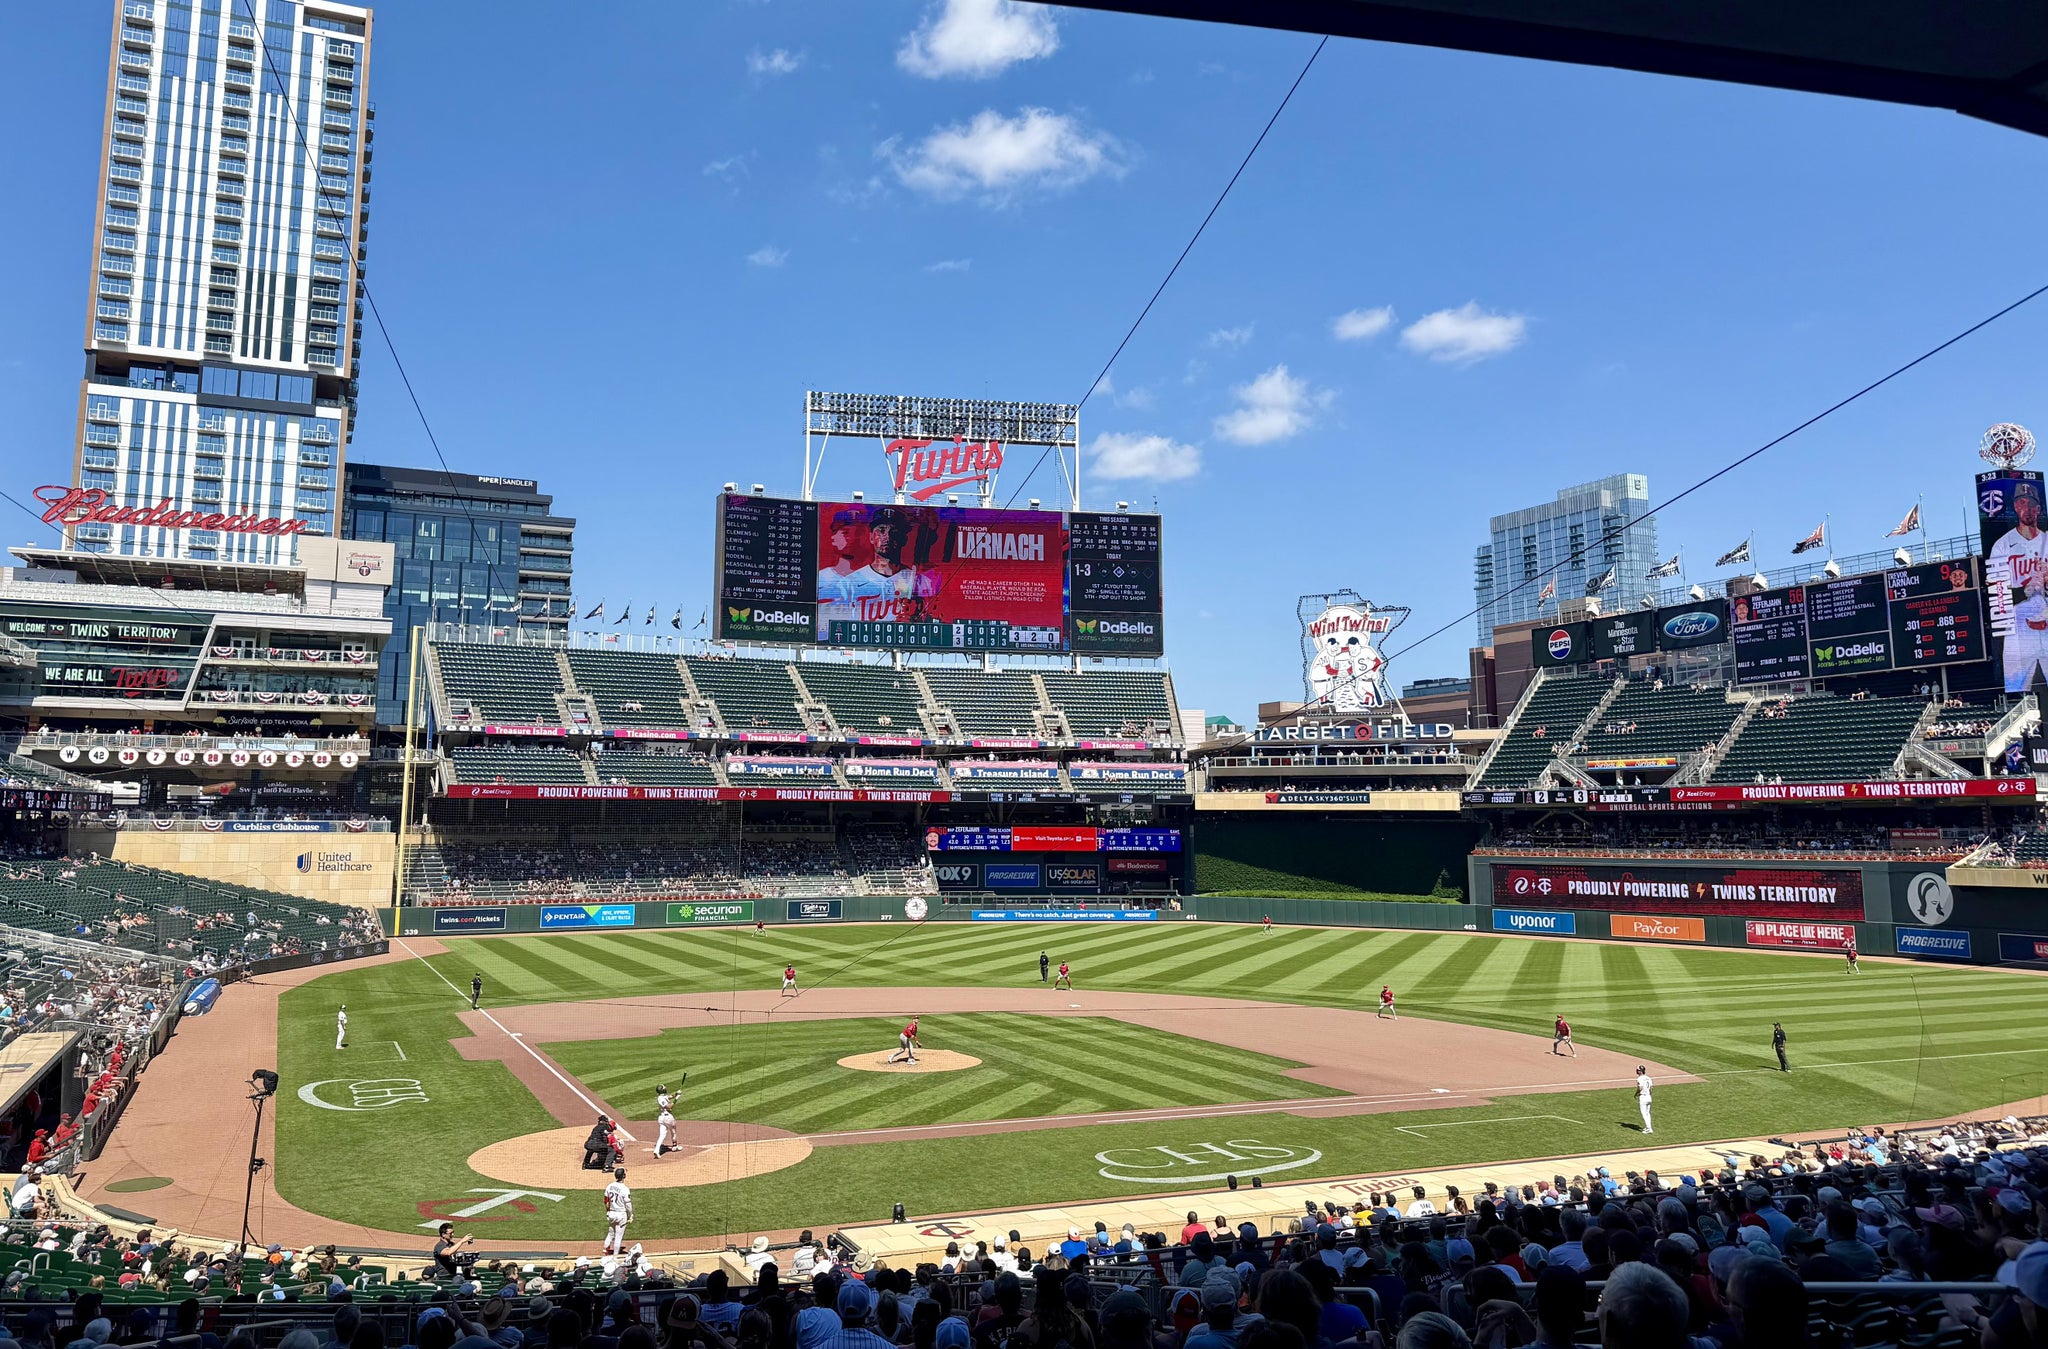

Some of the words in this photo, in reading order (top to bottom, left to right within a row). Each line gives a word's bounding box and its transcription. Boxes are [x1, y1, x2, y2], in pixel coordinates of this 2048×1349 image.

[886, 434, 1003, 502] Twins
[478, 476, 499, 485] PIPER
[502, 478, 533, 488] SANDLER
[1981, 472, 1996, 482] 3:23
[33, 485, 309, 535] Budweiser
[957, 532, 1044, 561] LARNACH
[1074, 564, 1091, 576] 1-3
[1888, 571, 1908, 580] TREVOR
[1940, 564, 1950, 580] 9
[1888, 576, 1920, 588] LARNACH
[1789, 589, 1803, 604] 56
[1894, 588, 1906, 599] 1-3
[753, 609, 810, 625] DaBella
[1099, 620, 1154, 635] DaBella
[1309, 616, 1342, 637] Win!
[1342, 614, 1390, 633] Twins!
[1614, 622, 1624, 630] The
[1674, 618, 1708, 634] Ford
[1905, 620, 1920, 631] .301
[1937, 616, 1954, 627] .868
[9, 622, 46, 633] WELCOME
[70, 623, 109, 638] TWINS
[117, 625, 178, 639] TERRITORY
[1608, 626, 1638, 637] Minnesota
[1621, 636, 1635, 644] Star
[1916, 635, 1921, 644] 2
[1945, 630, 1956, 640] 73
[1613, 644, 1635, 653] Tribune
[1835, 642, 1884, 658] DaBella
[1914, 649, 1922, 659] 13
[1946, 645, 1957, 655] 22
[45, 667, 61, 680] WE
[64, 668, 84, 681] ARE
[86, 668, 104, 682] ALL
[111, 667, 179, 697] Twins
[495, 727, 530, 735] Treasure
[532, 728, 558, 736] Island
[1255, 725, 1352, 741] TARGET
[1378, 724, 1453, 738] FIELD
[747, 734, 778, 742] Treasure
[779, 734, 800, 742] Island
[980, 740, 1009, 748] Treasure
[66, 750, 75, 758] W
[94, 752, 105, 760] 42
[180, 753, 190, 761] 10
[208, 754, 219, 762] 28
[234, 754, 246, 762] 34
[263, 755, 272, 763] 14
[346, 756, 352, 764] 3
[864, 767, 890, 776] Home
[892, 768, 910, 776] Run
[911, 768, 934, 776] Deck
[977, 770, 1018, 778] Treasure
[1020, 770, 1049, 778] Island
[1132, 770, 1150, 778] Run
[1150, 770, 1175, 779] Deck
[537, 787, 580, 798] PROUDLY
[581, 788, 628, 798] POWERING
[644, 788, 672, 798] TWINS
[674, 788, 719, 798] TERRITORY
[776, 790, 812, 800] PROUDLY
[814, 790, 854, 800] POWERING
[867, 791, 890, 800] TWINS
[892, 792, 932, 800] TERRITORY
[1742, 786, 1787, 799] PROUDLY
[1790, 785, 1845, 798] POWERING
[1864, 784, 1900, 796] TWINS
[1902, 782, 1966, 795] TERRITORY
[1538, 792, 1545, 802] 2
[1578, 792, 1583, 802] 3
[1678, 802, 1712, 810] AUCTIONS
[233, 822, 271, 831] Carbliss
[272, 822, 320, 831] Clubhouse
[318, 852, 352, 862] United
[317, 862, 372, 872] Healthcare
[1127, 862, 1160, 870] Budweiser
[962, 866, 972, 881] 9
[988, 871, 1036, 880] PROGRESSIVE
[1568, 880, 1620, 896] PROUDLY
[1624, 882, 1689, 898] POWERING
[1712, 884, 1755, 900] TWINS
[1759, 886, 1836, 904] TERRITORY
[694, 904, 742, 916] securian
[440, 916, 500, 924] twins.com/tickets
[1510, 914, 1556, 928] uponor
[1634, 922, 1680, 936] Paycor
[1755, 924, 1765, 936] NO
[1766, 924, 1799, 938] PLACE
[1800, 926, 1815, 938] LIKE
[1817, 926, 1845, 940] HERE
[1900, 935, 1967, 950] PROGRESSIVE
[2035, 944, 2048, 954] US
[1329, 1174, 1420, 1196] Twins
[610, 1192, 619, 1202] 27
